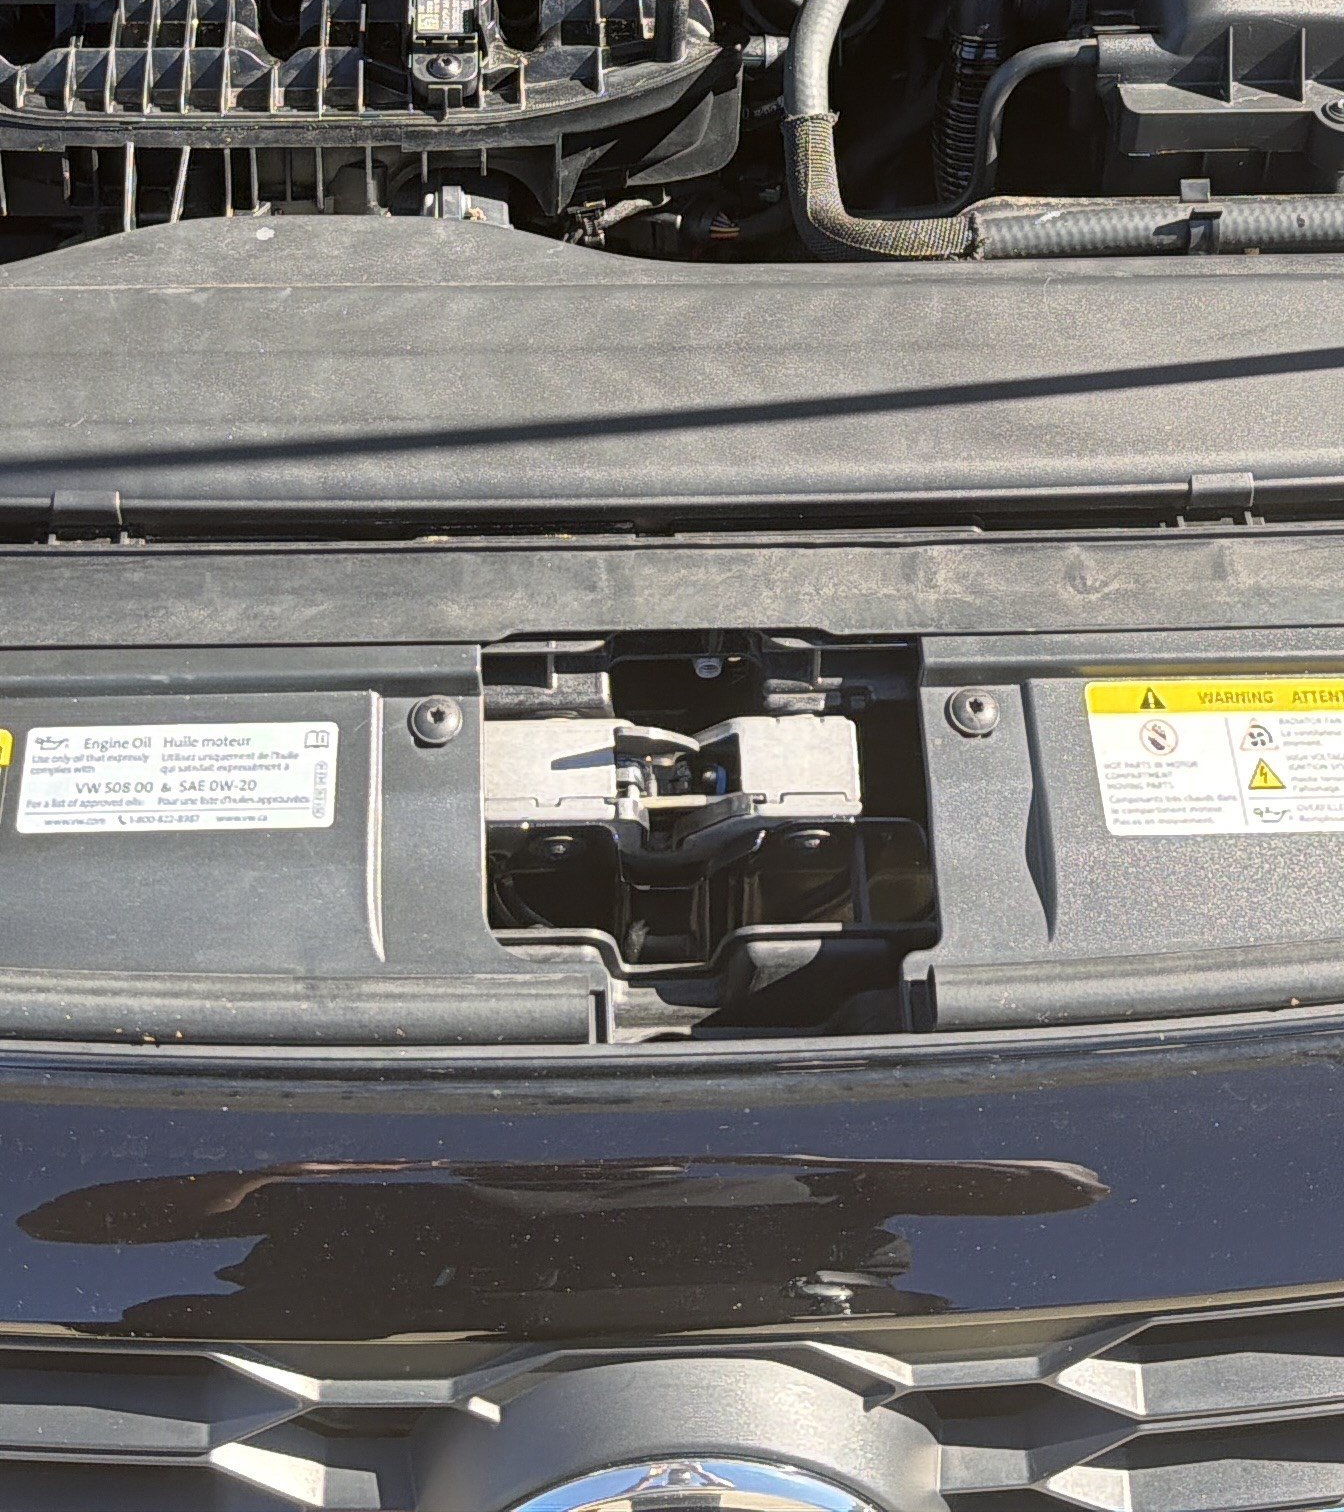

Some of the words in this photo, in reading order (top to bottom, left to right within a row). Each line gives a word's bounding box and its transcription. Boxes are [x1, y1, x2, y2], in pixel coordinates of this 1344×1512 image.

[1197, 690, 1274, 705] WARNING
[84, 737, 129, 752] Engine
[132, 736, 151, 749] Oil
[163, 736, 199, 748] Huile
[202, 737, 251, 748] moteur
[75, 782, 101, 794] VW
[105, 781, 131, 794] 508
[134, 781, 154, 793] 00
[160, 783, 171, 792] &
[179, 780, 206, 792] SAE
[209, 779, 258, 792] 0W-20
